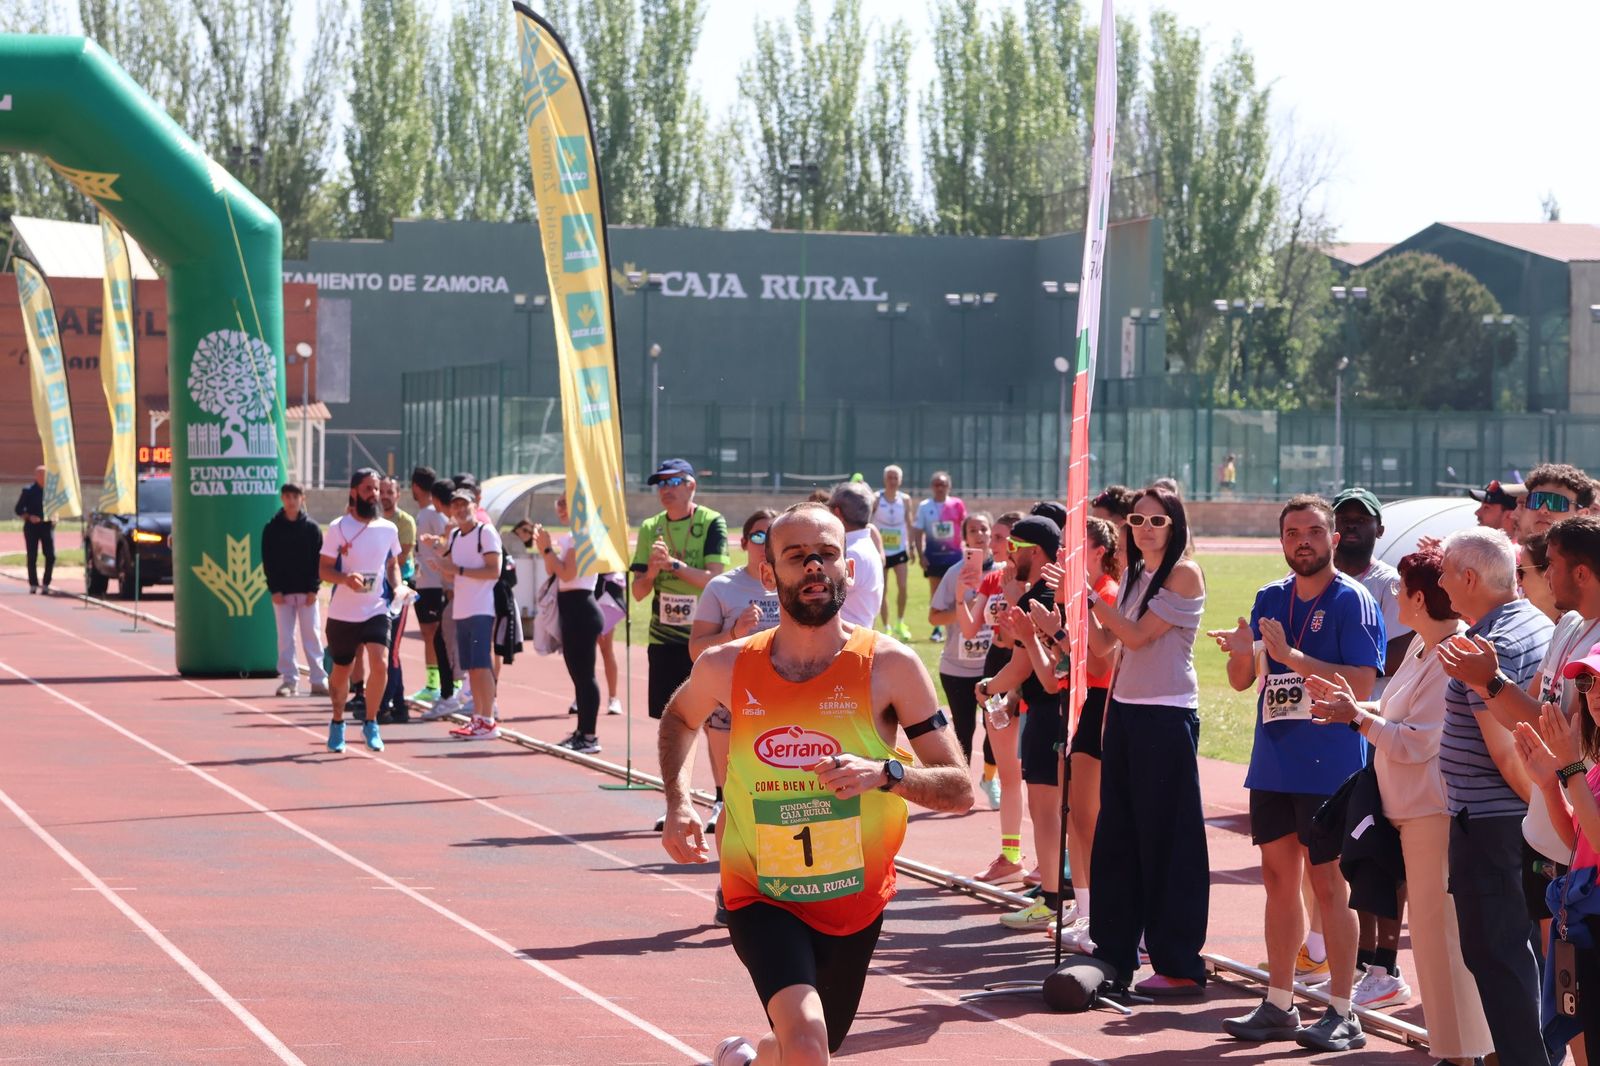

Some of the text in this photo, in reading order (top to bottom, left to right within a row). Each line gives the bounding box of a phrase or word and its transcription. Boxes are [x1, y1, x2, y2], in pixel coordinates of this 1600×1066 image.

[388, 274, 416, 291] DE
[422, 275, 510, 293] ZAMORA
[661, 271, 888, 301] CAJA RURAL
[190, 465, 278, 480] FUNDACION
[190, 480, 279, 496] CAJA RURAL
[664, 603, 691, 616] 846
[1273, 677, 1306, 686] ZAMORA
[819, 701, 858, 710] SERRANO
[762, 738, 834, 758] Serrano
[755, 781, 780, 792] COME
[783, 780, 806, 792] BIEN
[809, 780, 815, 791] Y
[780, 807, 833, 820] CAJA RURAL
[793, 826, 814, 867] 1
[790, 876, 860, 895] CAJA RURAL
